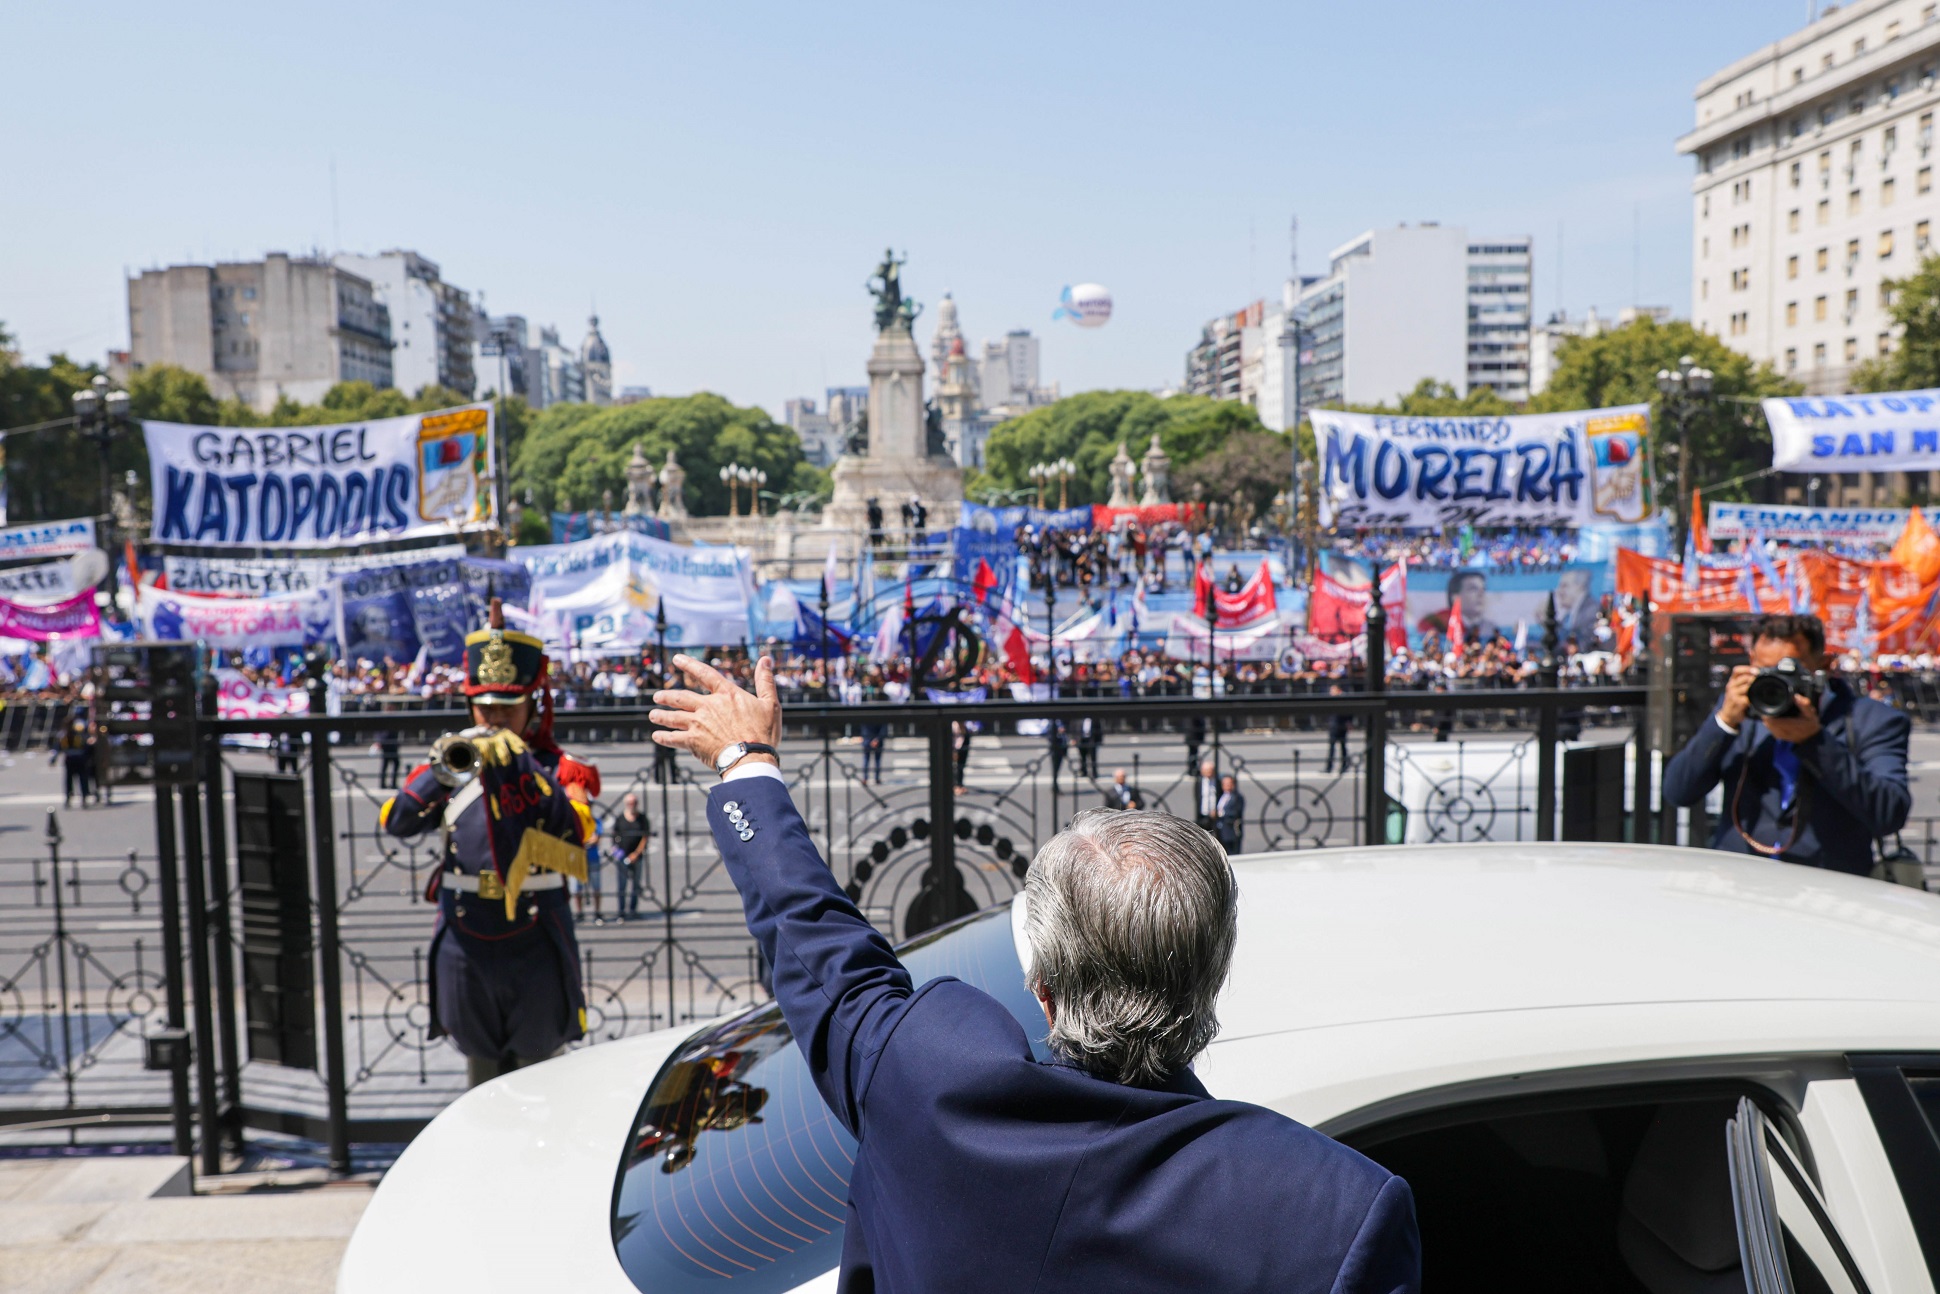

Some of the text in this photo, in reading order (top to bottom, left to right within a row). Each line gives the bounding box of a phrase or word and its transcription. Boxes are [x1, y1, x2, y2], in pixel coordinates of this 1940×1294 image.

[1374, 417, 1511, 442] FERNANDO
[192, 428, 376, 467] GABRIEL
[1811, 431, 1894, 457] SAN
[1323, 423, 1583, 502] MOREIRA
[162, 463, 410, 543] KATOPODIS
[1716, 509, 1896, 524] FERNANDO
[187, 615, 302, 637] VICTORIA
